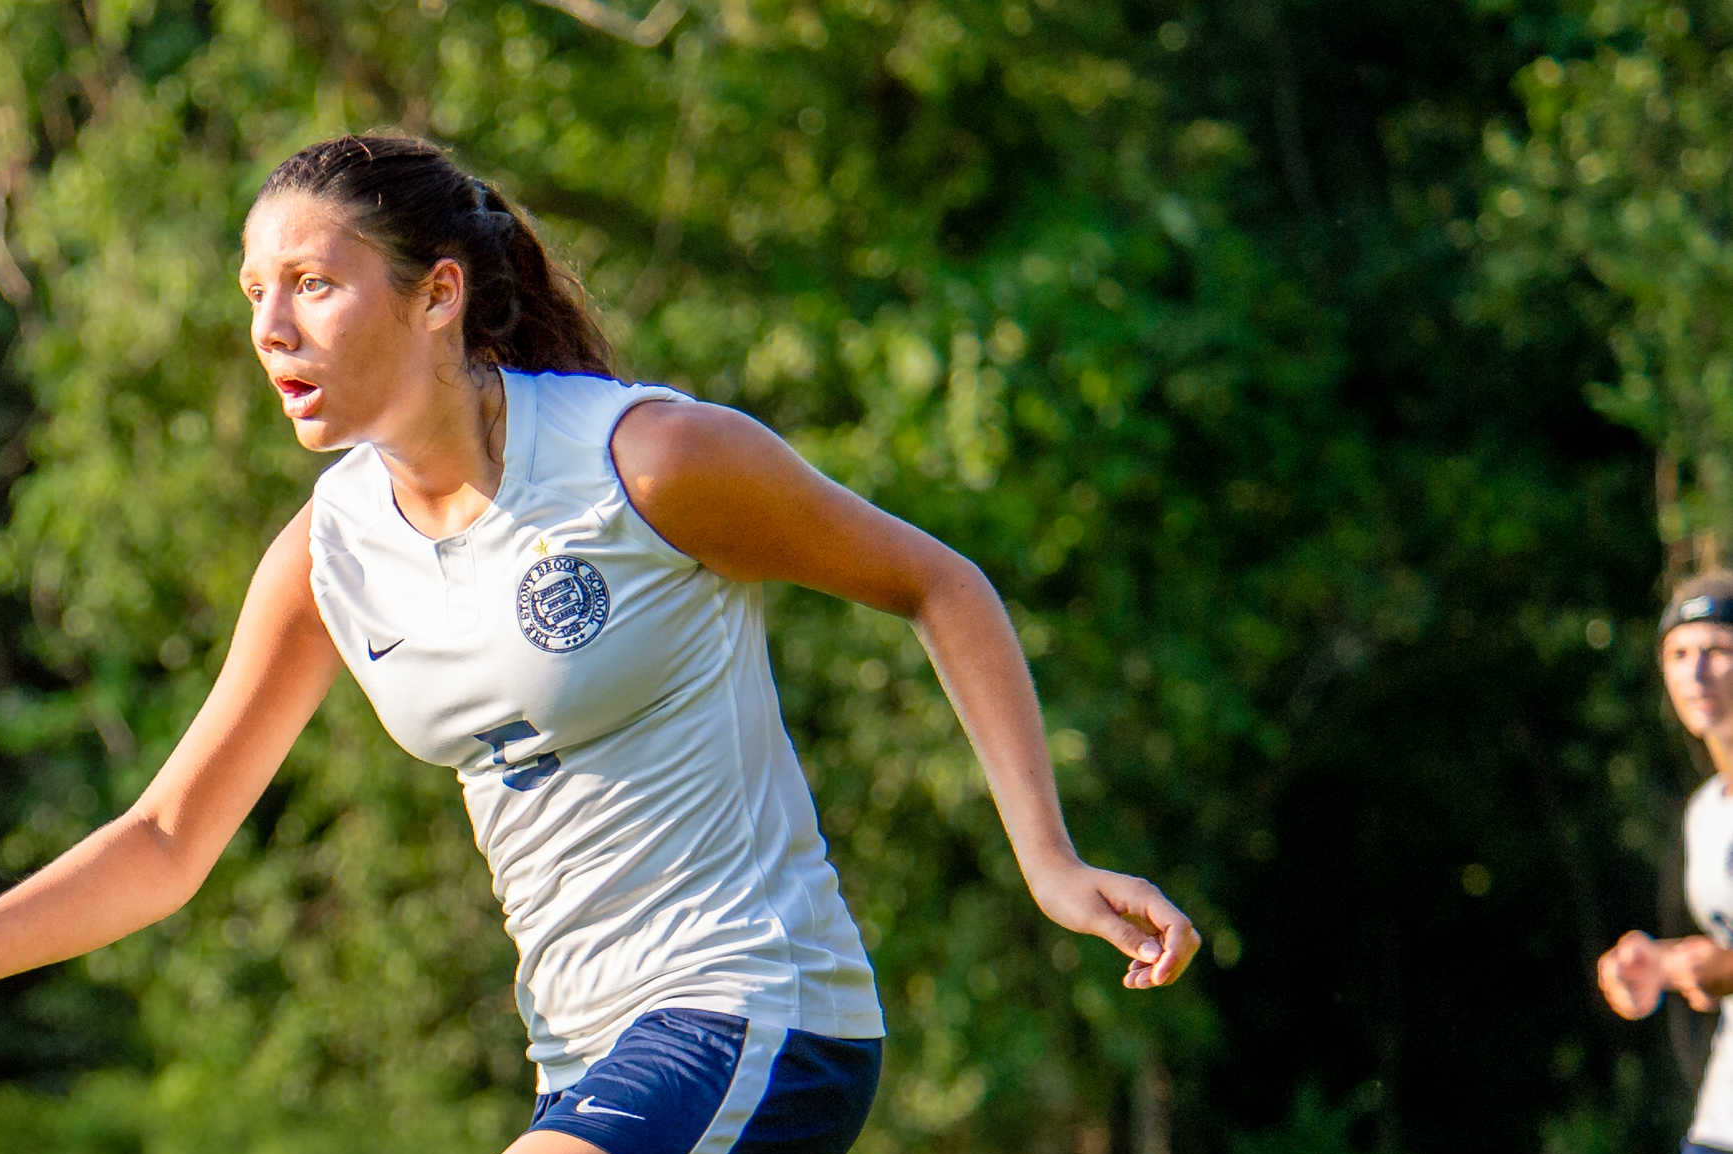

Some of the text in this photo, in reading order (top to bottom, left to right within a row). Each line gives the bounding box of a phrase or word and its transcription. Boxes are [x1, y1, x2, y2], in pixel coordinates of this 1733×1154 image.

[535, 559, 584, 577] BROOK
[520, 575, 536, 620] STONY
[586, 572, 606, 625] SCHOOL
[525, 623, 550, 647] THE
